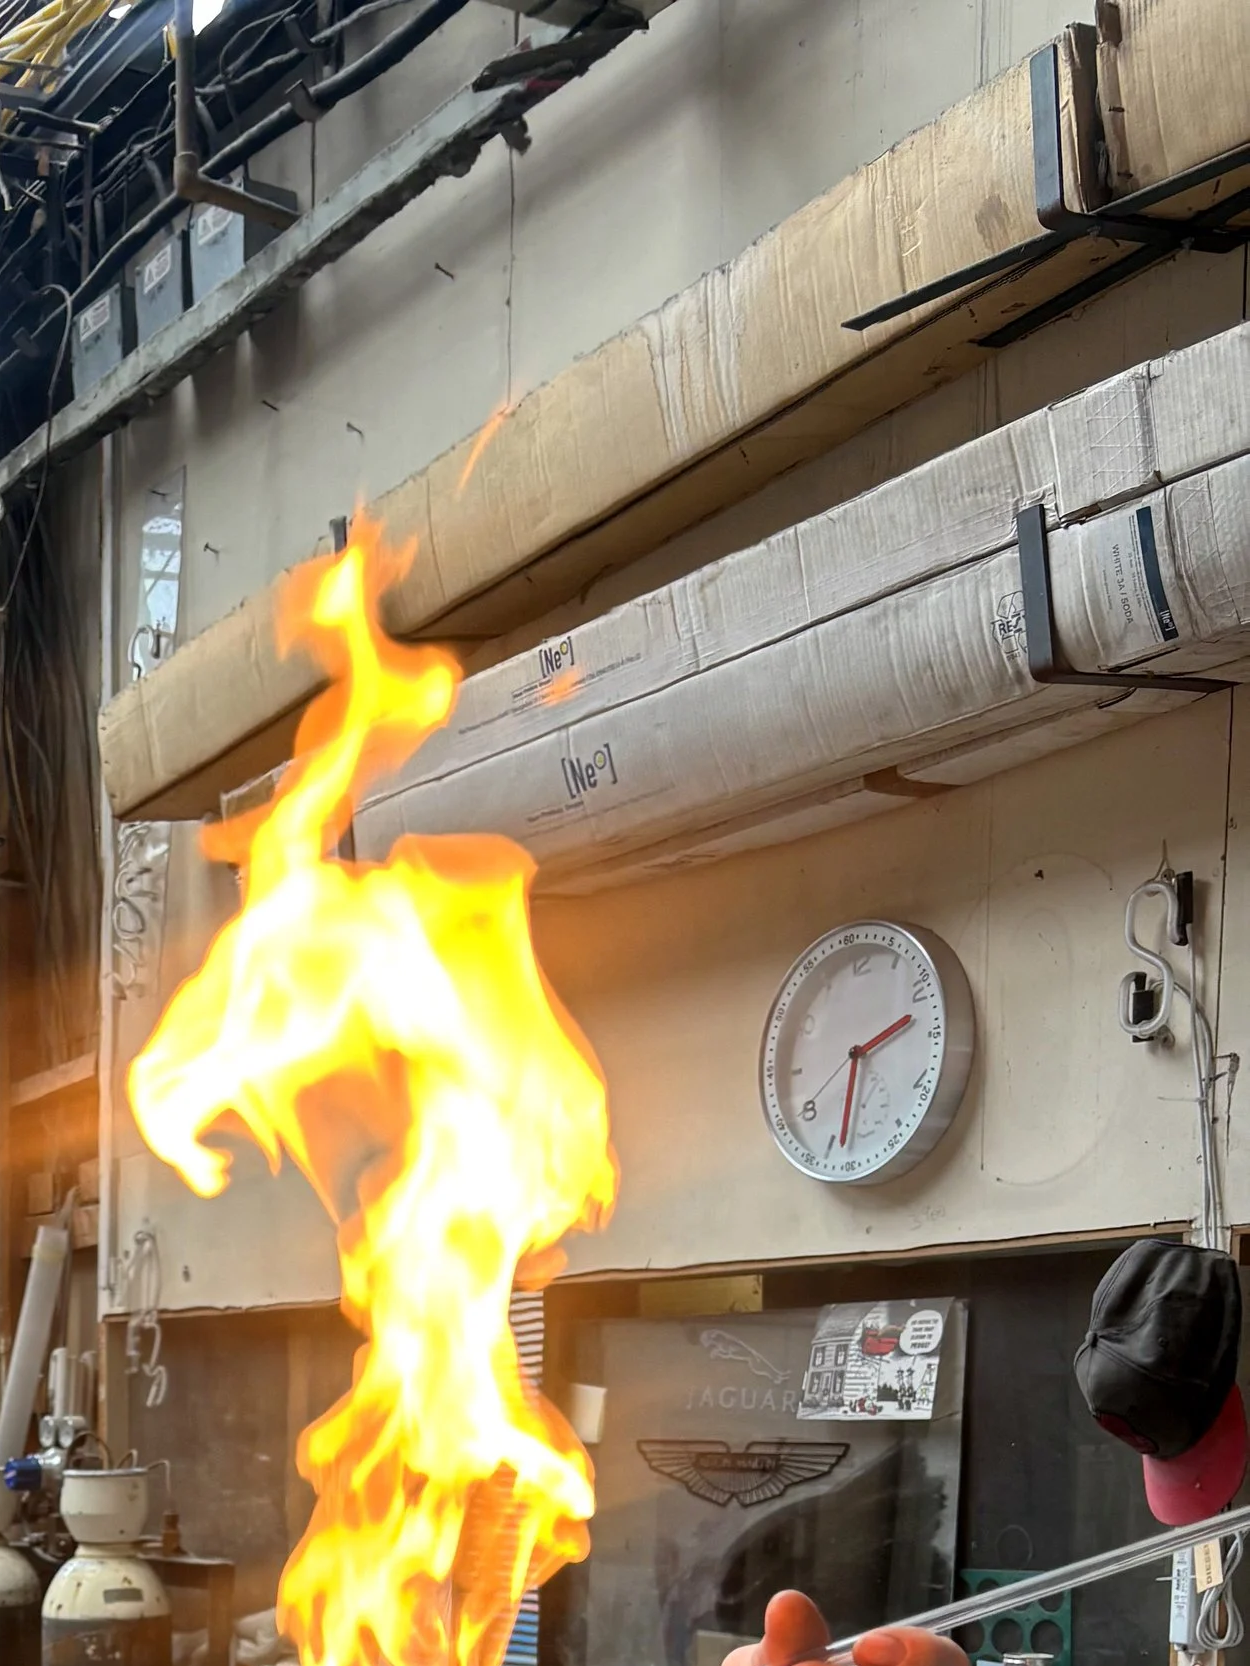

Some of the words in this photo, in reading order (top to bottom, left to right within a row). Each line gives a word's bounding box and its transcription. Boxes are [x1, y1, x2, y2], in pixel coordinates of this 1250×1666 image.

[843, 933, 855, 945] 60
[887, 936, 895, 947] 5
[803, 960, 815, 974] 55
[919, 968, 930, 982] 10
[932, 1024, 942, 1039] 15
[920, 1085, 931, 1101] 20
[802, 1100, 817, 1122] 8
[887, 1133, 901, 1149] 25
[844, 1160, 857, 1172] 30
[686, 1386, 797, 1413] JAGUAR
